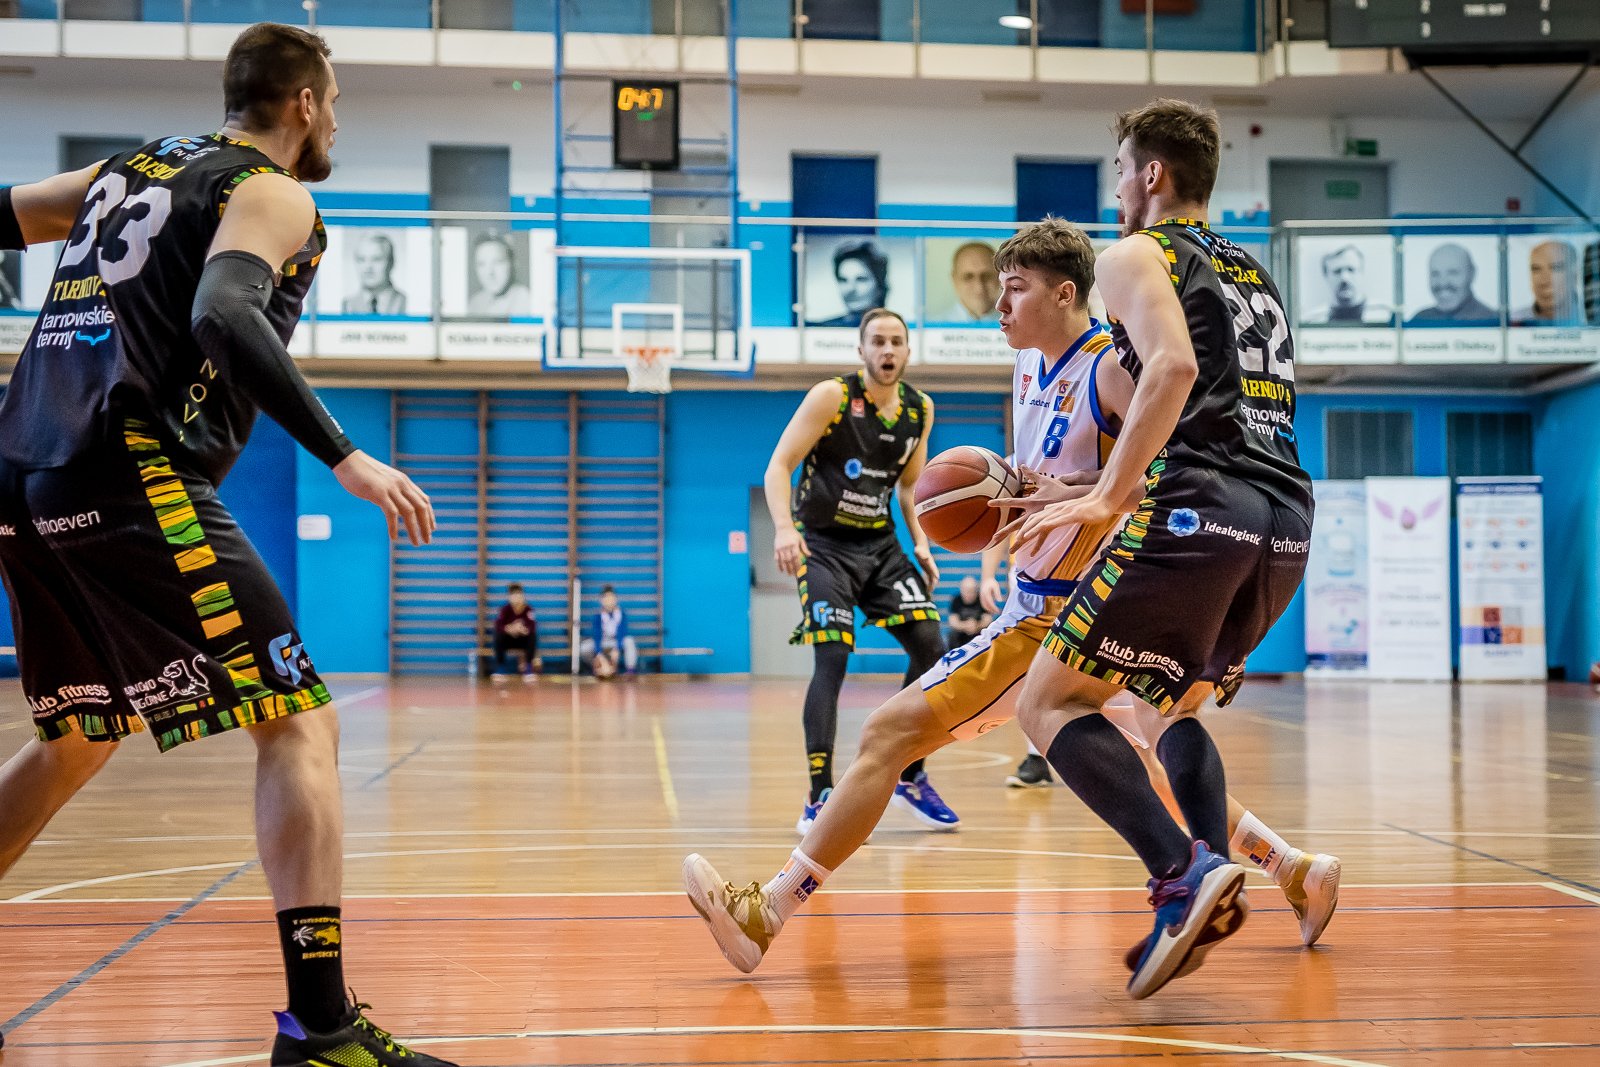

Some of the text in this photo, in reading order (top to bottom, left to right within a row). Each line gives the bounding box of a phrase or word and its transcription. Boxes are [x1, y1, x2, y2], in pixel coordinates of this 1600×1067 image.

[58, 172, 172, 287] 33
[36, 330, 75, 350] termy
[1218, 278, 1295, 382] 22
[1042, 414, 1072, 460] 8
[1203, 521, 1262, 546] Idealogistic
[893, 577, 926, 602] 11
[1099, 636, 1185, 678] klub fitness
[57, 684, 110, 700] fitness
